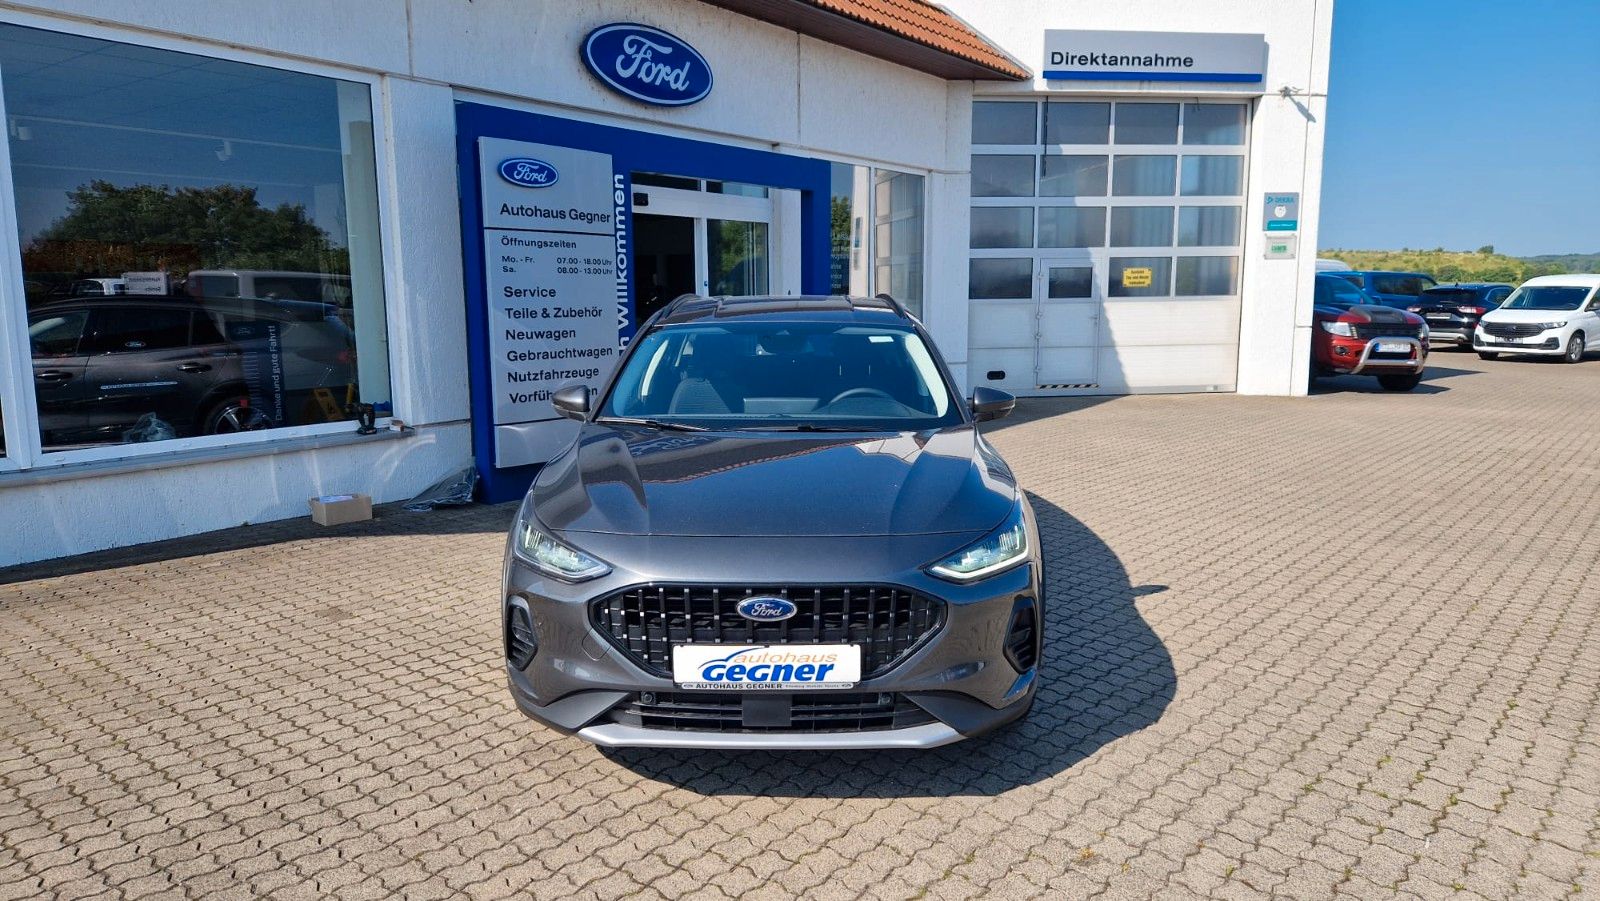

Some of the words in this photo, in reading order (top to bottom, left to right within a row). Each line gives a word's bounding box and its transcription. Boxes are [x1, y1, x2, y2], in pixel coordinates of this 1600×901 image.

[615, 35, 691, 92] Ford
[1050, 51, 1194, 68] Direktannahme
[513, 162, 548, 183] Ford
[500, 203, 567, 219] Autohaus
[568, 208, 611, 224] Gegner
[501, 235, 577, 249] Öffnungszeiten
[502, 255, 518, 263] Mo.
[614, 174, 629, 330] Willkommen
[503, 265, 516, 273] Sa.
[504, 286, 557, 298] Service
[505, 308, 538, 319] Teile
[541, 308, 550, 319] &
[553, 306, 603, 318] Zubehör
[505, 329, 576, 341] Neuwagen
[507, 347, 613, 362] Gebrauchtwagen
[508, 367, 599, 383] Nutzfahrzeuge
[750, 602, 783, 616] Ford
[733, 651, 838, 664] autohaus
